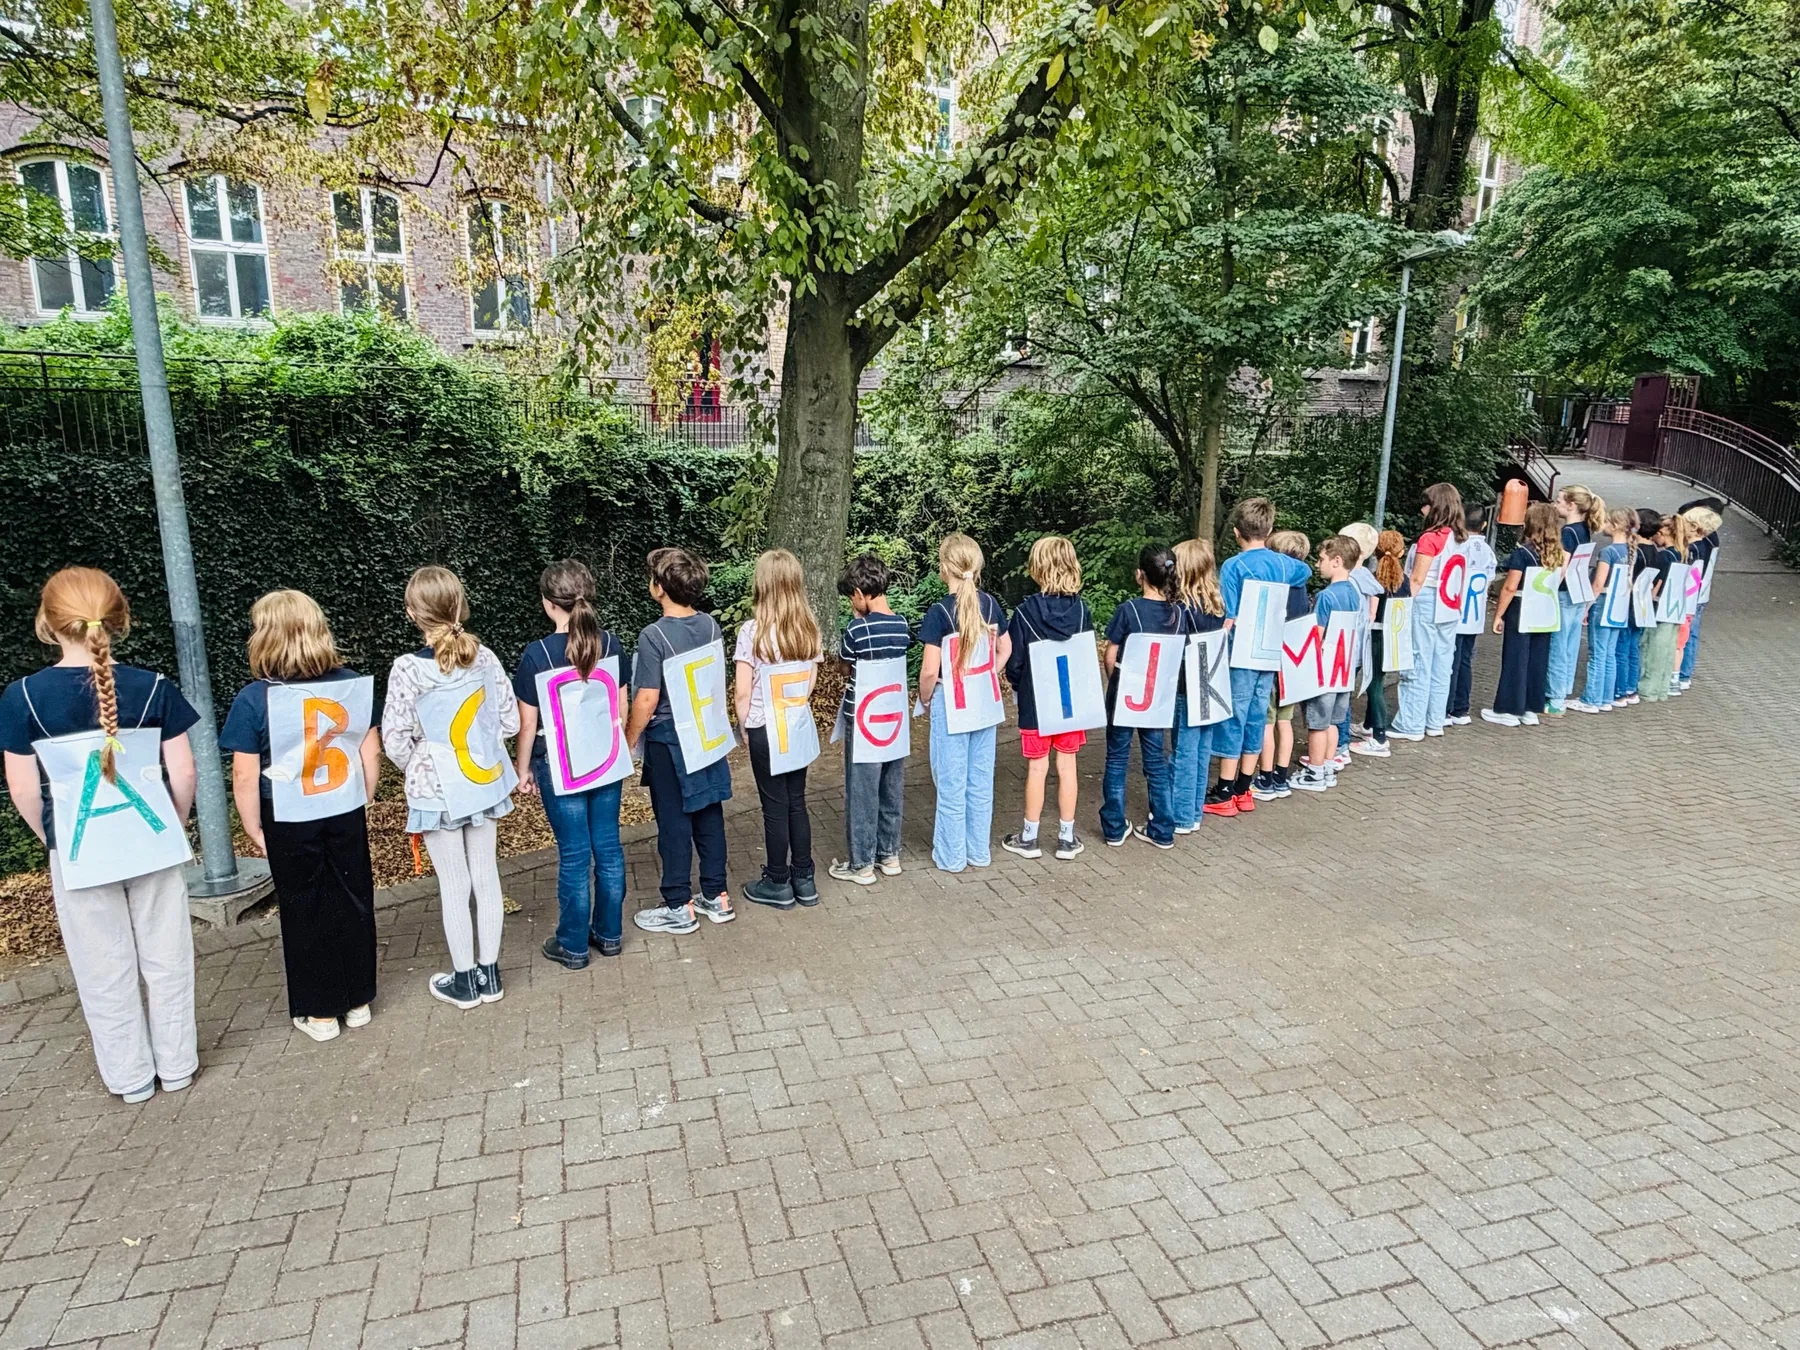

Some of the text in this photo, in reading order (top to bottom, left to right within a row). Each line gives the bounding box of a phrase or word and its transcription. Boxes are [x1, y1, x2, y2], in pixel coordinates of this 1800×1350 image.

[1439, 554, 1465, 616] Q
[1462, 573, 1488, 624] R
[1529, 571, 1560, 632] S
[1572, 552, 1591, 602] T
[1251, 585, 1281, 660] L
[1329, 629, 1355, 687] N
[1391, 599, 1405, 670] P
[950, 626, 1000, 709] H
[1056, 655, 1073, 719] I
[1125, 642, 1160, 712] J
[1197, 632, 1232, 721] K
[1279, 625, 1325, 700] M
[449, 685, 504, 785] C
[547, 668, 620, 791] D
[684, 656, 727, 752] E
[769, 671, 811, 754] F
[856, 684, 903, 747] G
[302, 698, 349, 795] B
[69, 750, 167, 861] A
